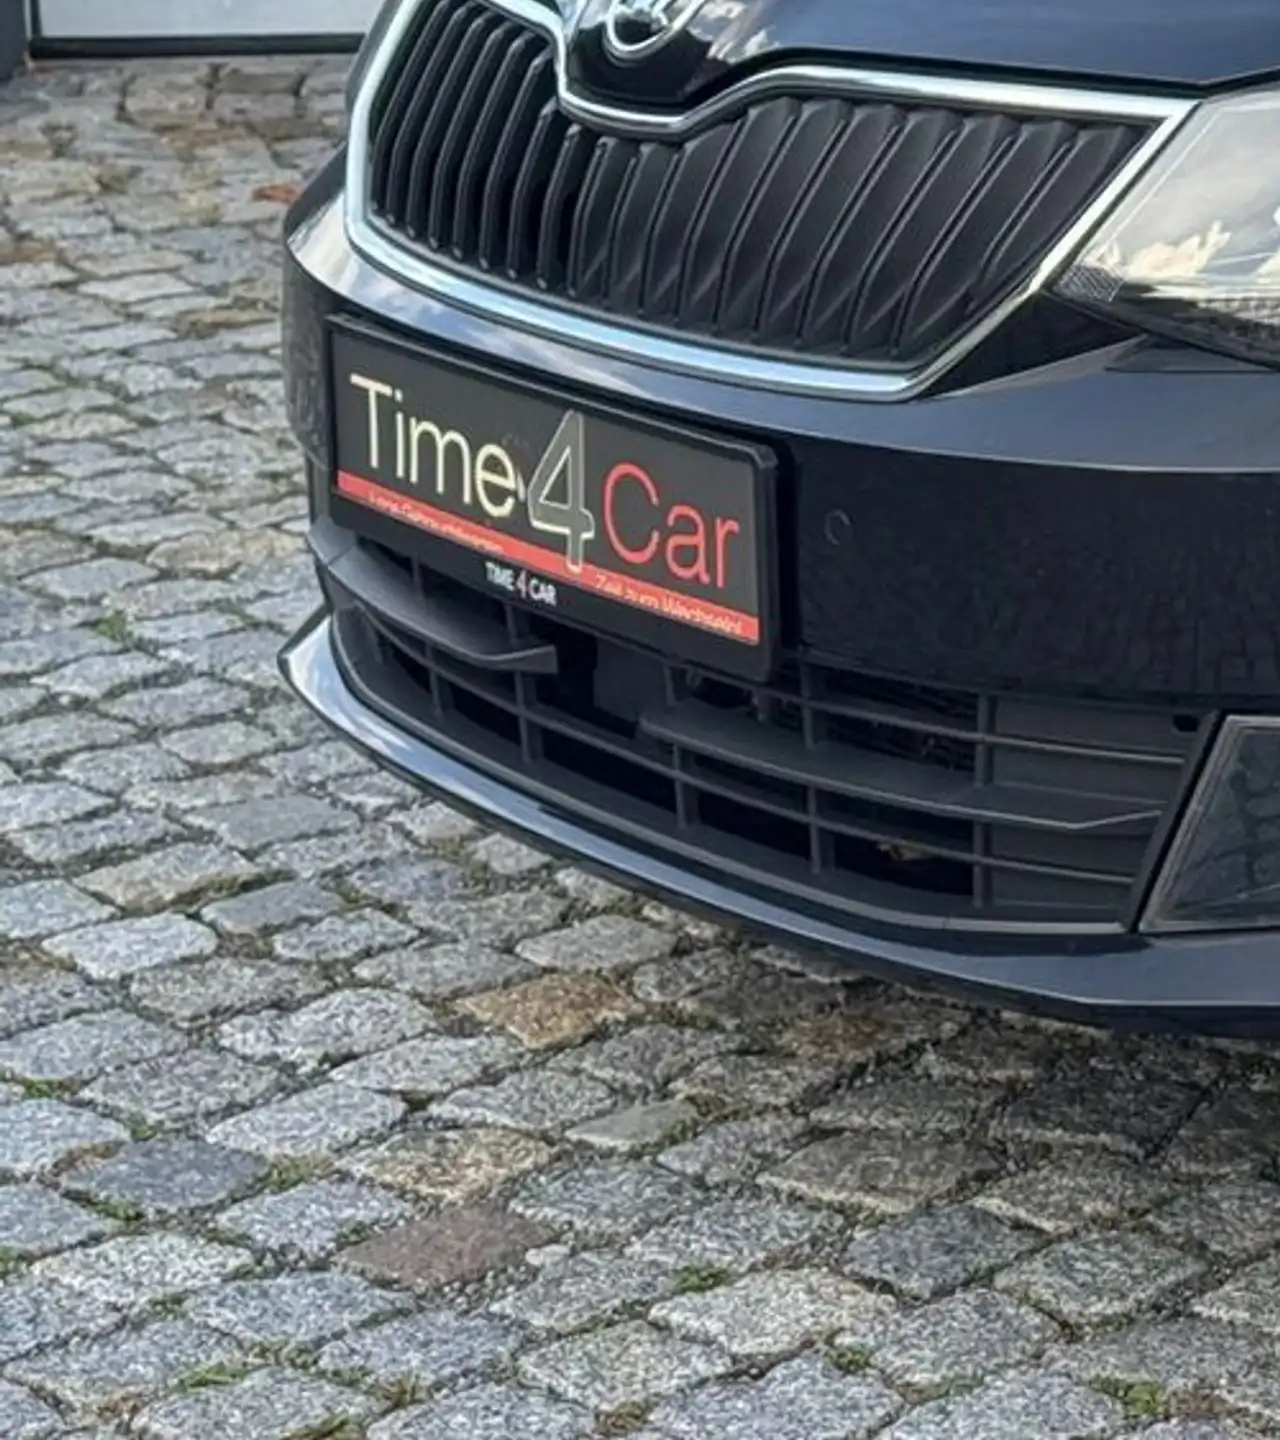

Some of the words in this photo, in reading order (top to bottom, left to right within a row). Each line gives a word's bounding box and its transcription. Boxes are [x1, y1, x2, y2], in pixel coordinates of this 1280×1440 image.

[349, 372, 517, 519] Time
[527, 408, 595, 573] 4
[603, 462, 741, 589] Car
